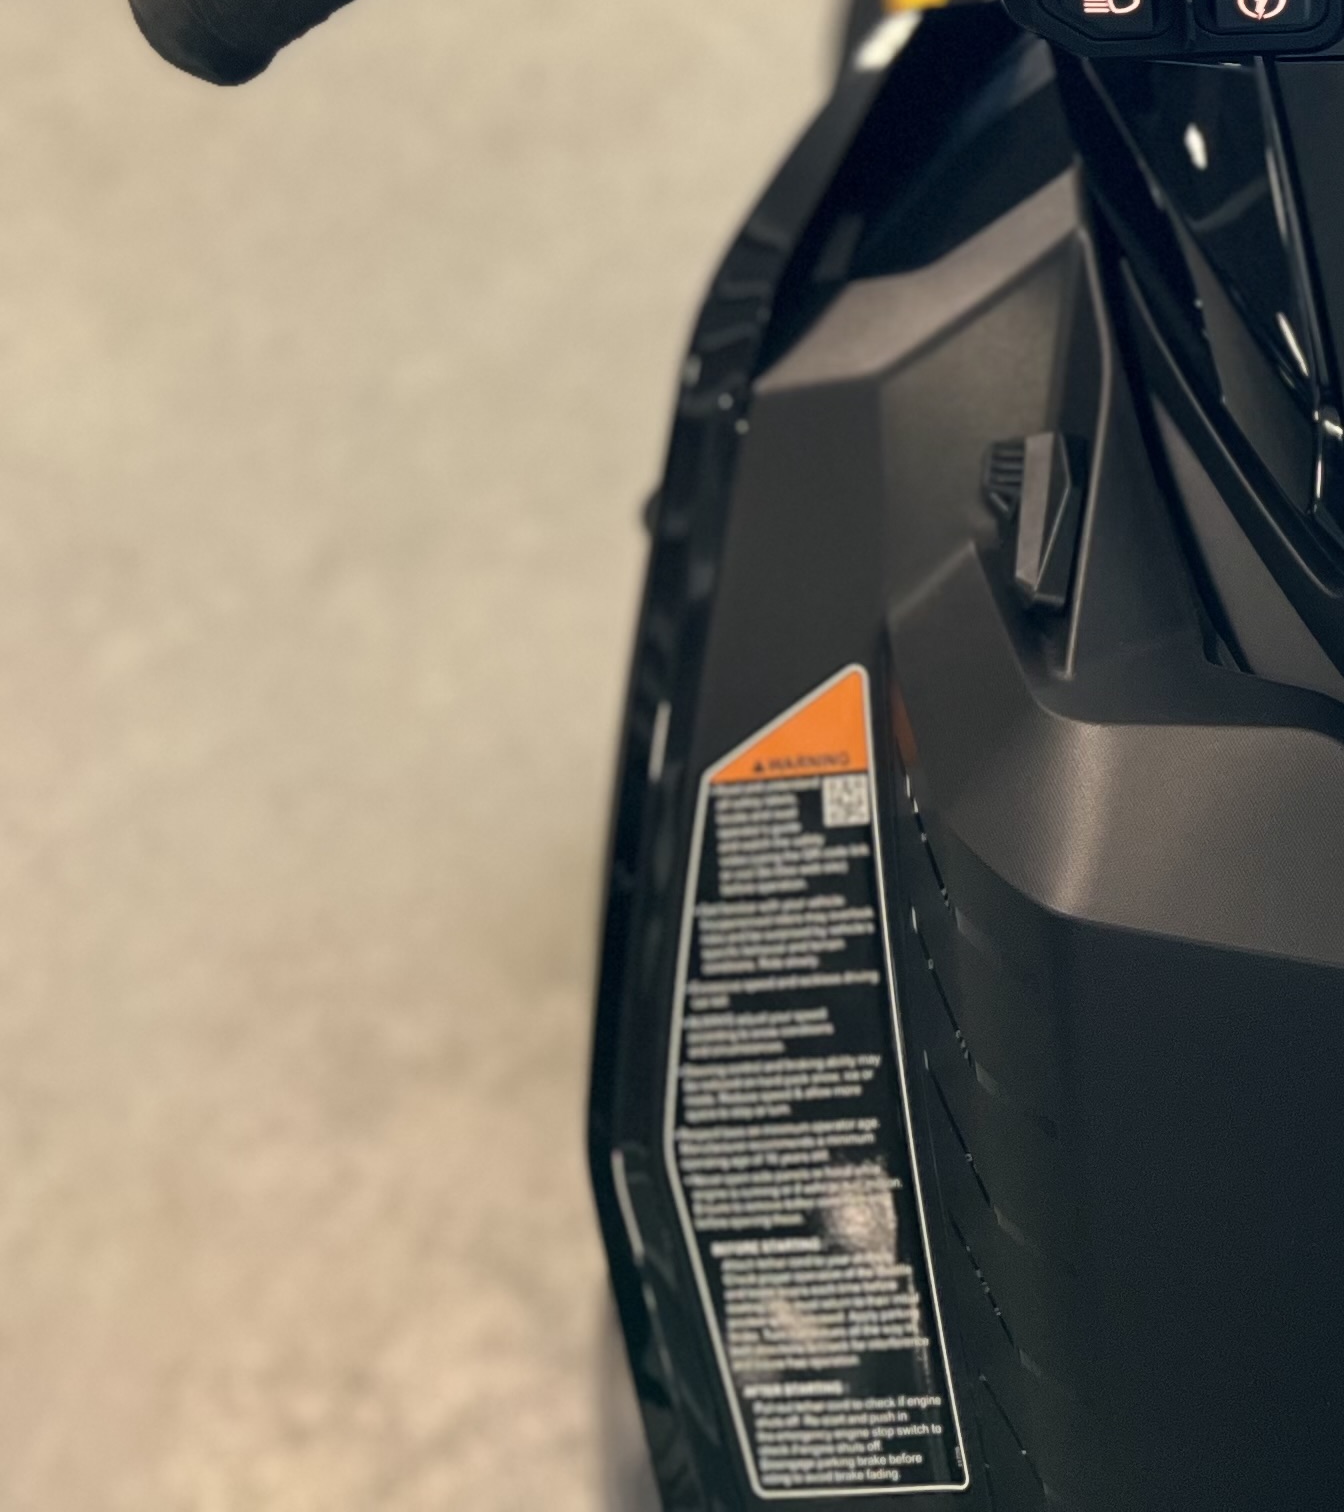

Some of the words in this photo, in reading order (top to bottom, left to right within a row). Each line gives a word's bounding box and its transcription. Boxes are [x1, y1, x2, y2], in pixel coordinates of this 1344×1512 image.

[906, 1396, 942, 1409] engine
[871, 1426, 894, 1439] stop
[896, 1424, 930, 1437] switch
[931, 1423, 942, 1434] to
[856, 1454, 887, 1465] brake
[888, 1452, 923, 1464] before
